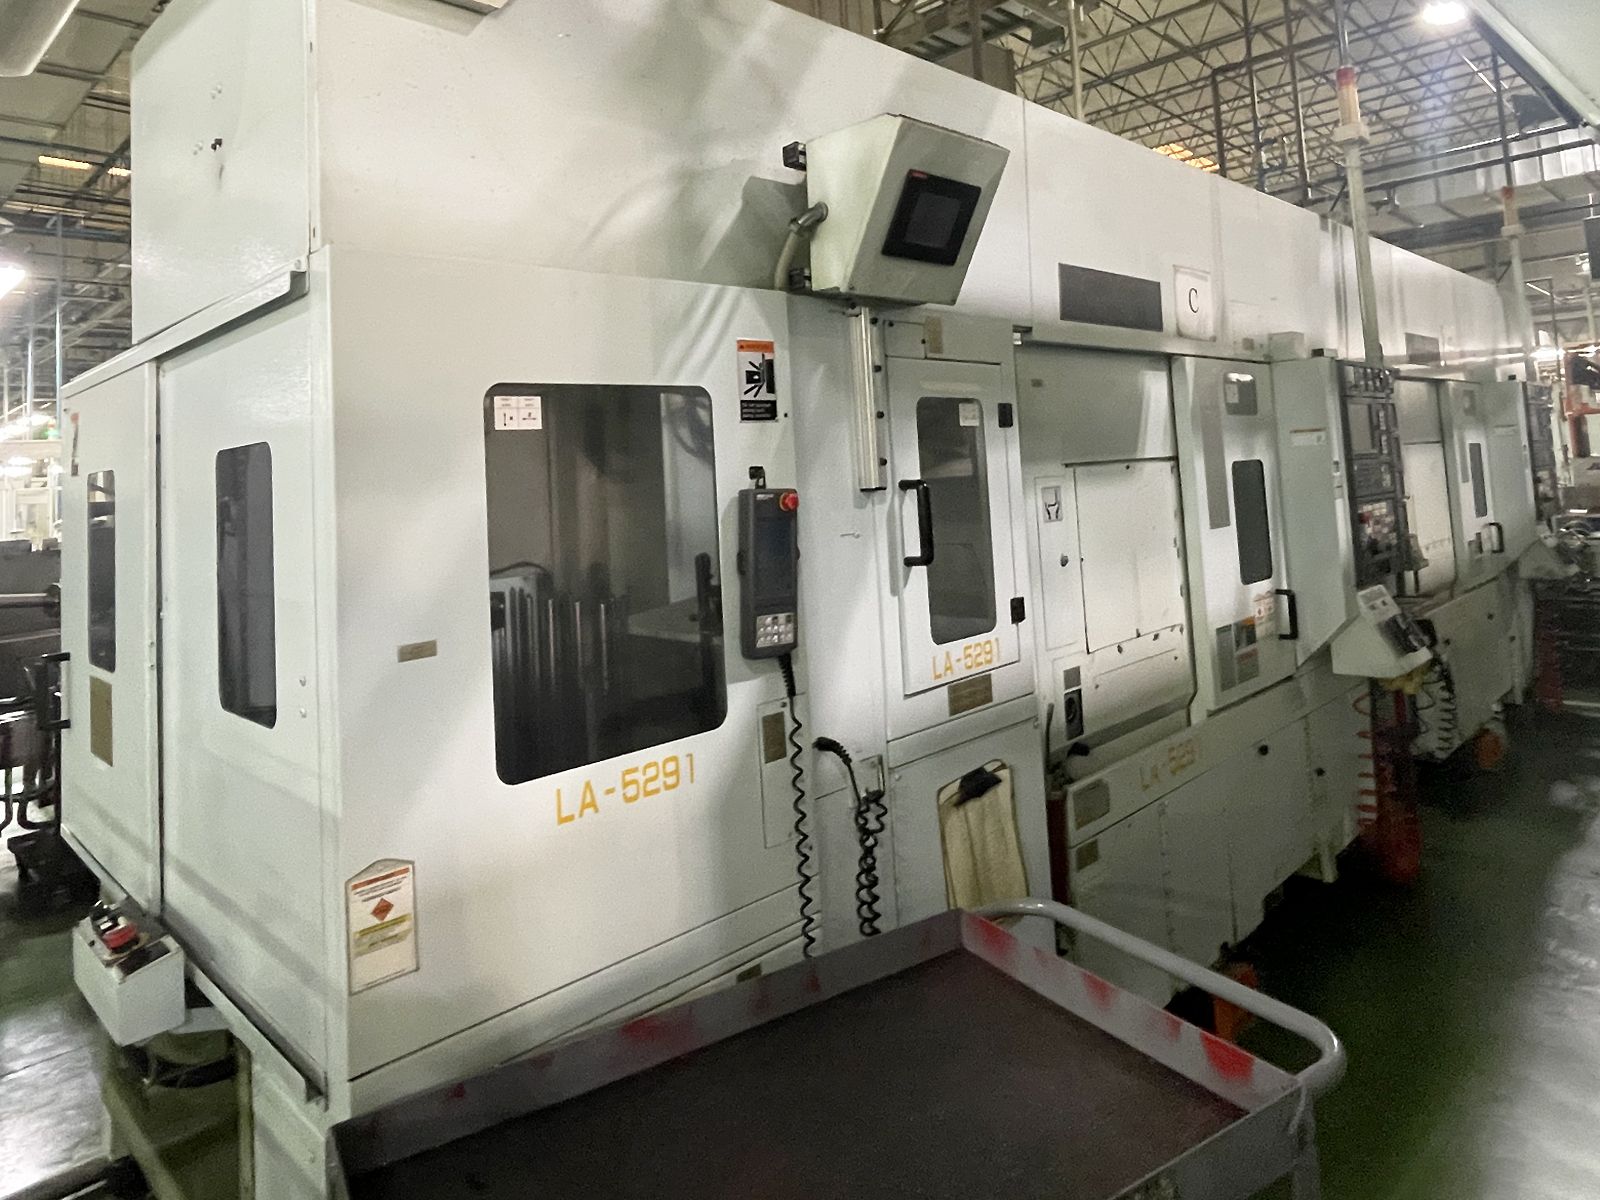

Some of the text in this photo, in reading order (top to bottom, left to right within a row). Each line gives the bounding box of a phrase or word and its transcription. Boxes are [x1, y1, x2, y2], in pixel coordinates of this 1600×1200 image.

[1189, 287, 1199, 313] C
[931, 637, 1000, 680] LA-5291
[556, 752, 694, 825] LA-5291
